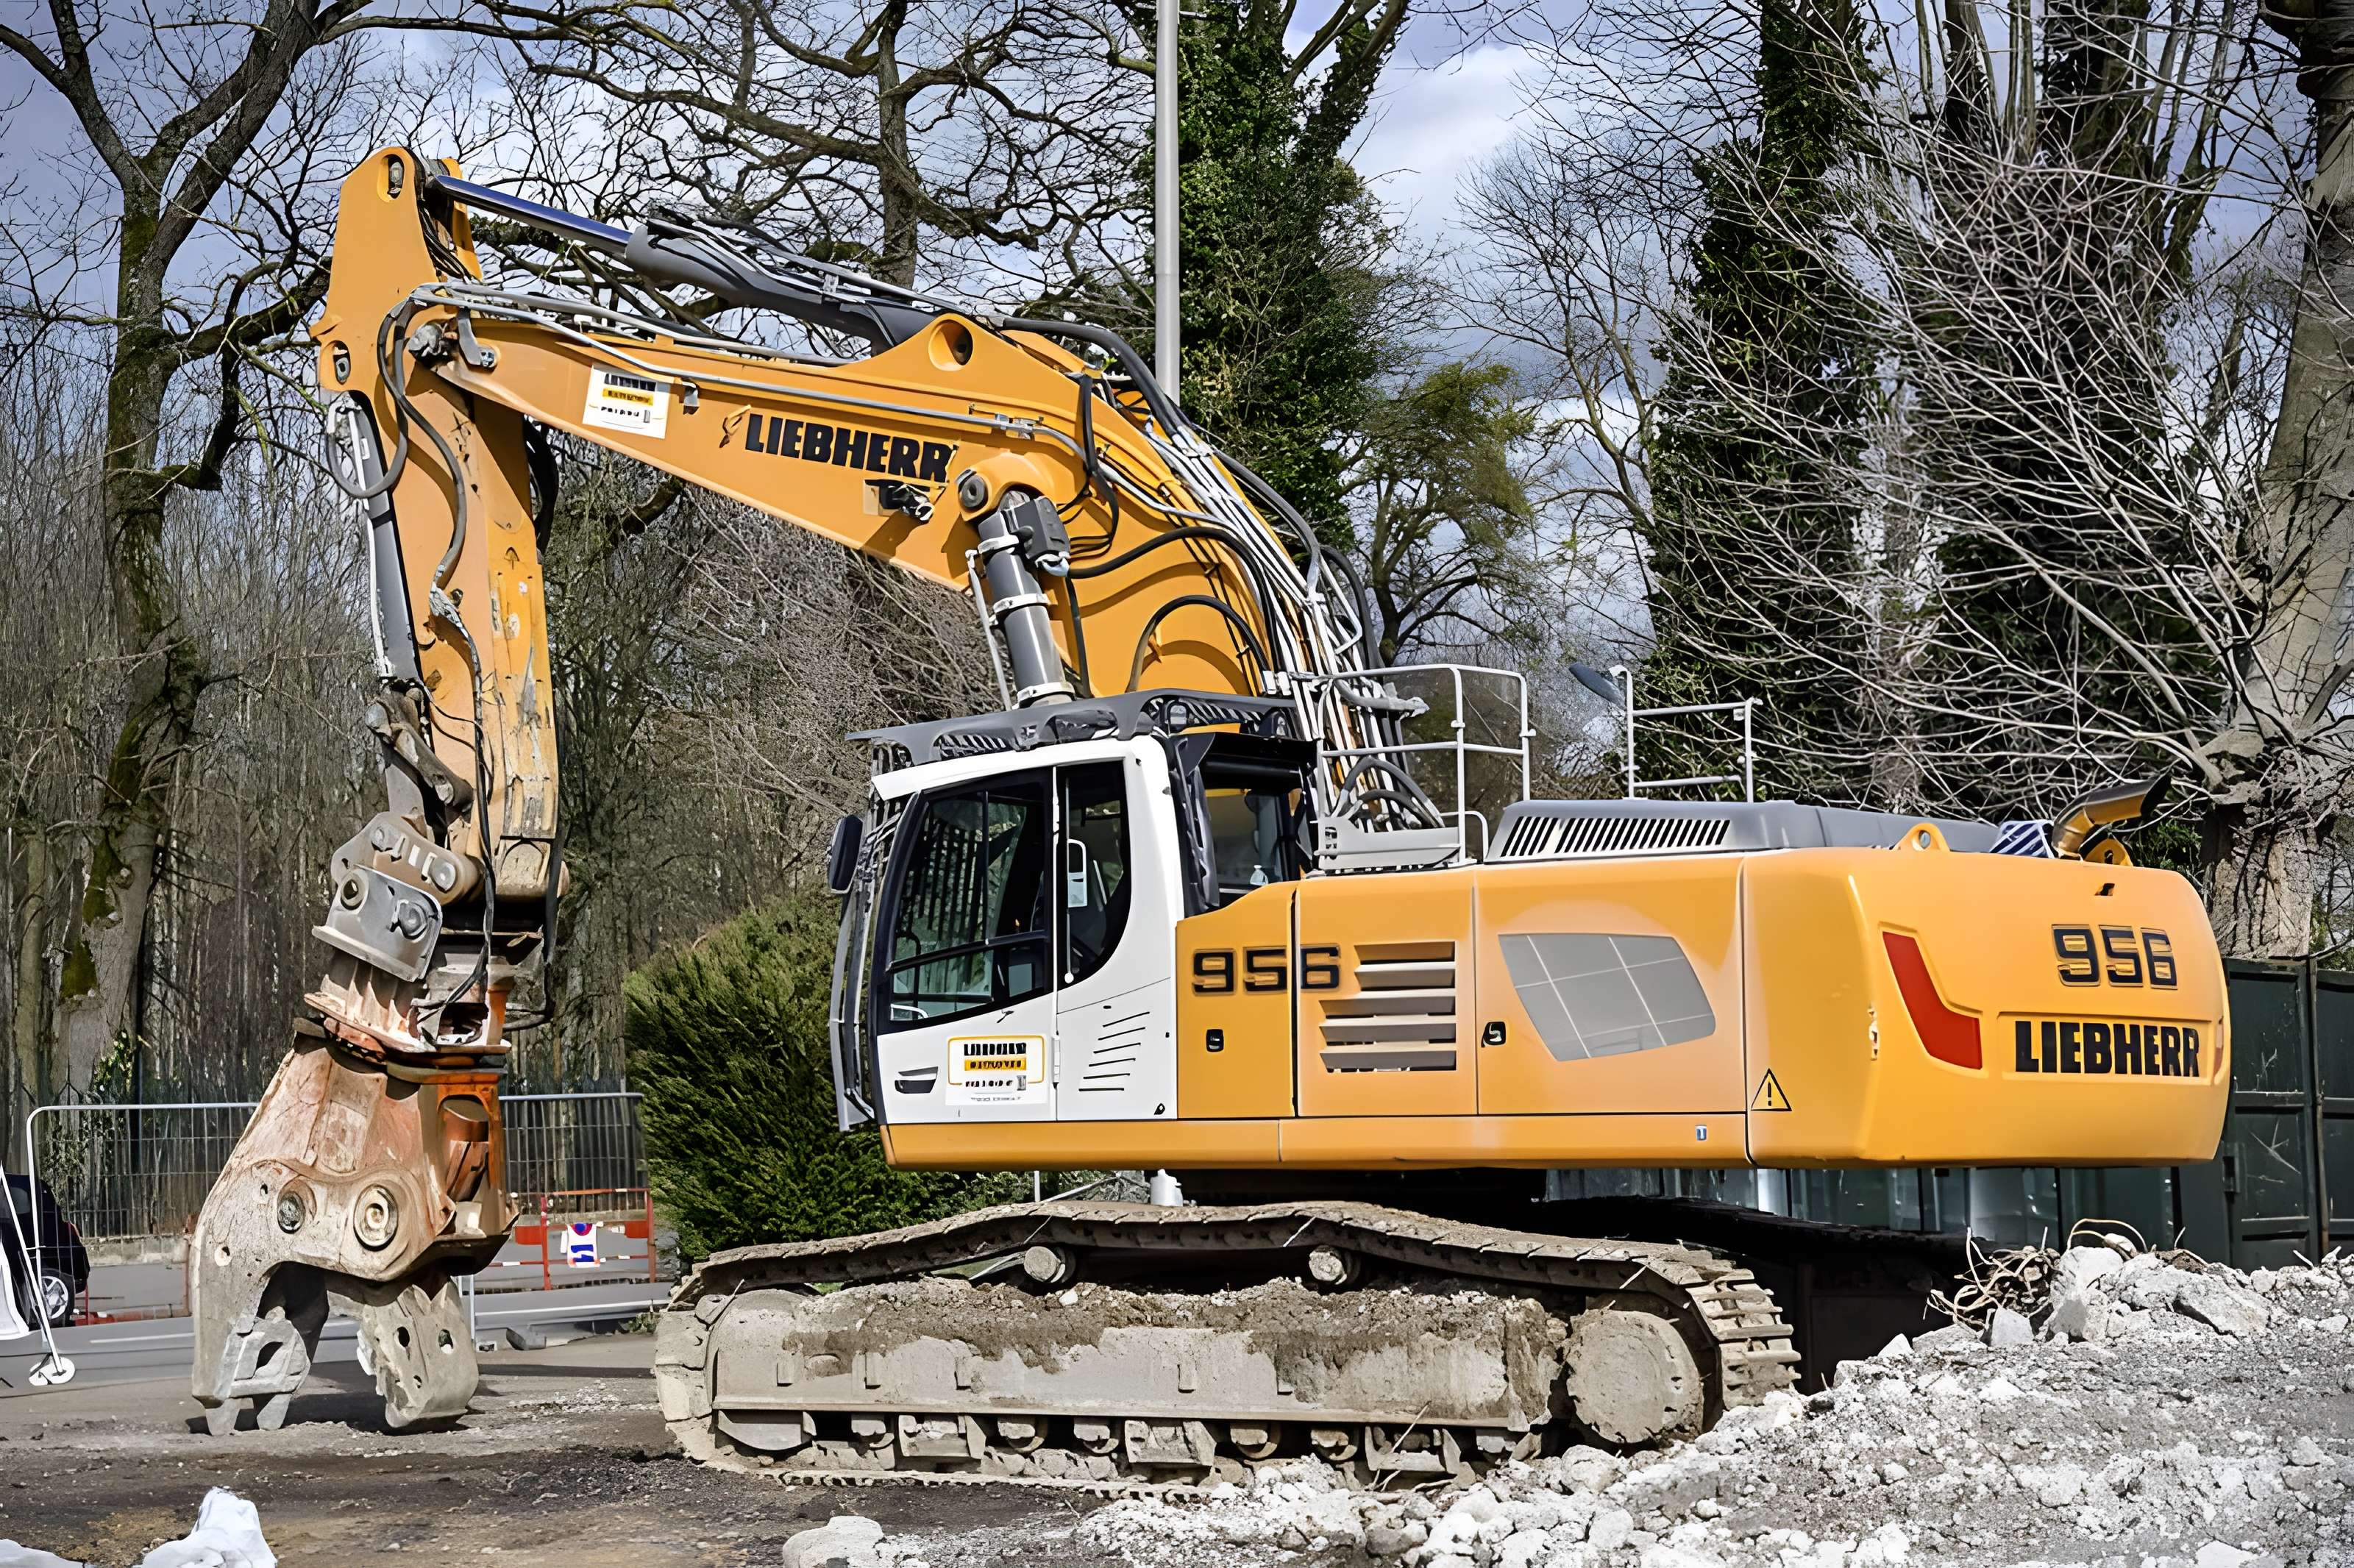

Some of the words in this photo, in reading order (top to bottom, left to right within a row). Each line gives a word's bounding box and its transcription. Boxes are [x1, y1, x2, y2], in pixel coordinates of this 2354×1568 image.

[745, 413, 951, 482] LIEBHERR
[1192, 944, 1340, 995] 956
[2052, 924, 2177, 989] 956
[2015, 1020, 2200, 1077] LIEBHERR
